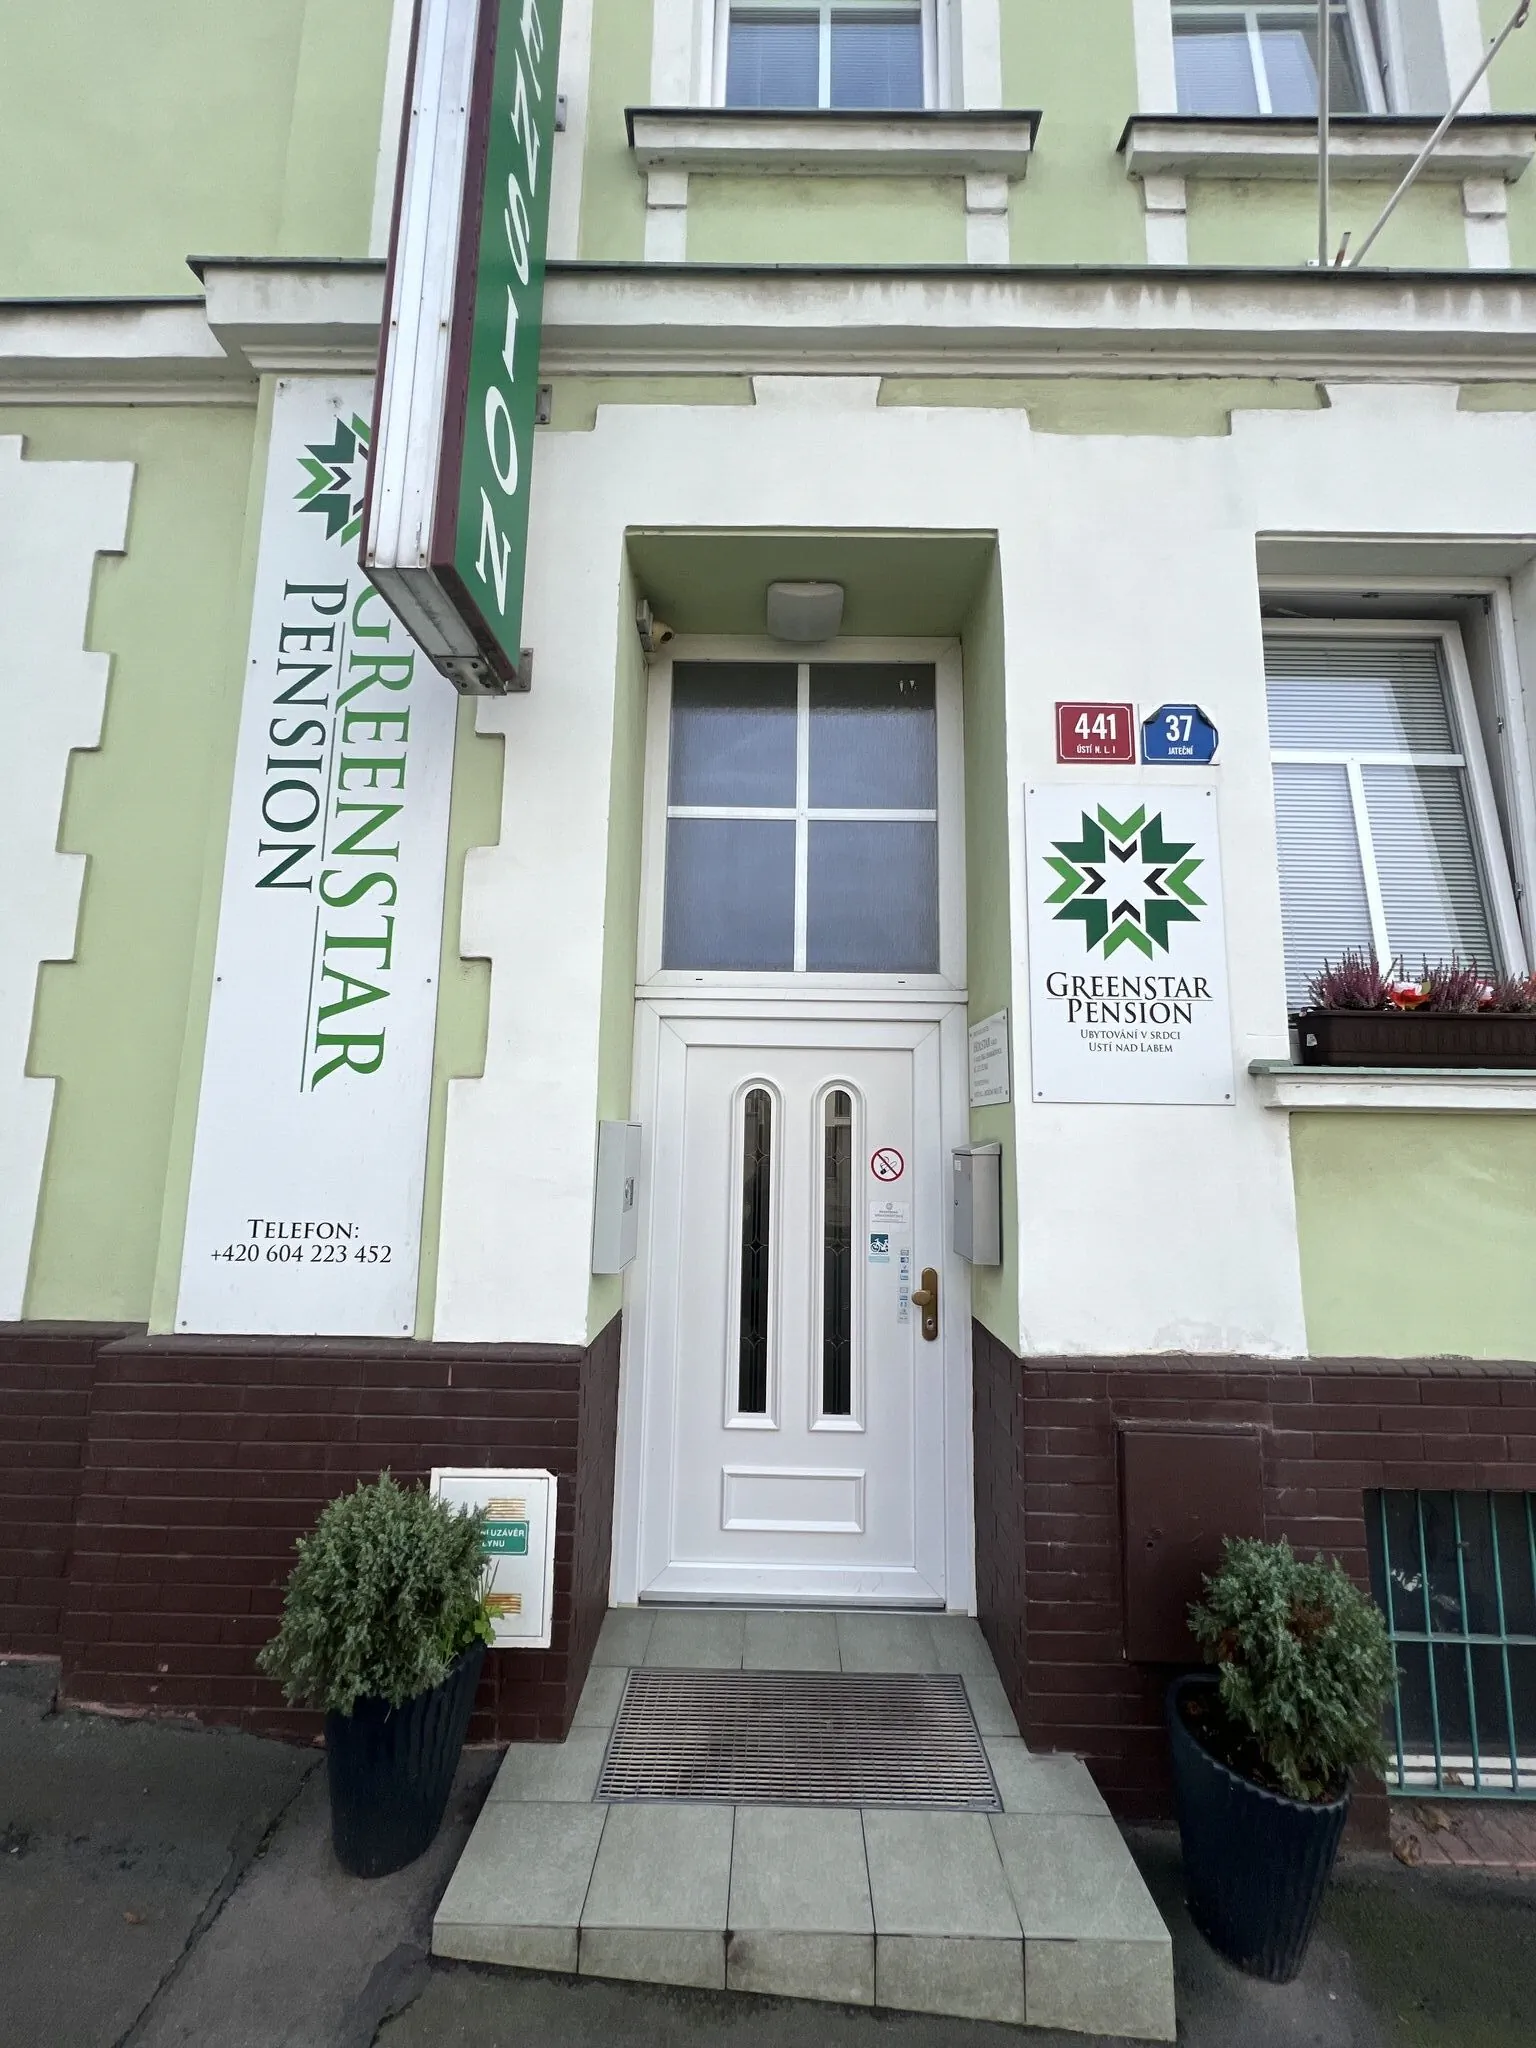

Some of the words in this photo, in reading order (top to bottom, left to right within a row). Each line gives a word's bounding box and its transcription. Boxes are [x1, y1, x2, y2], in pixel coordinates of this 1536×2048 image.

[255, 579, 349, 893] PENSION
[1074, 712, 1117, 740] 441
[1165, 715, 1192, 742] 37
[1076, 744, 1093, 754] ÚSTÍ
[1168, 745, 1193, 755] JATEČNÍ
[1046, 972, 1212, 1000] GREENSTAR
[1067, 998, 1192, 1024] PENSION
[1151, 1031, 1181, 1040] SRDCI
[1116, 1044, 1138, 1053] NAD
[1140, 1043, 1173, 1053] LABEM
[248, 1219, 359, 1239] TELEFON:
[211, 1244, 259, 1262] +420
[267, 1244, 304, 1262] 604
[311, 1245, 347, 1263] 223
[354, 1245, 392, 1263] 452
